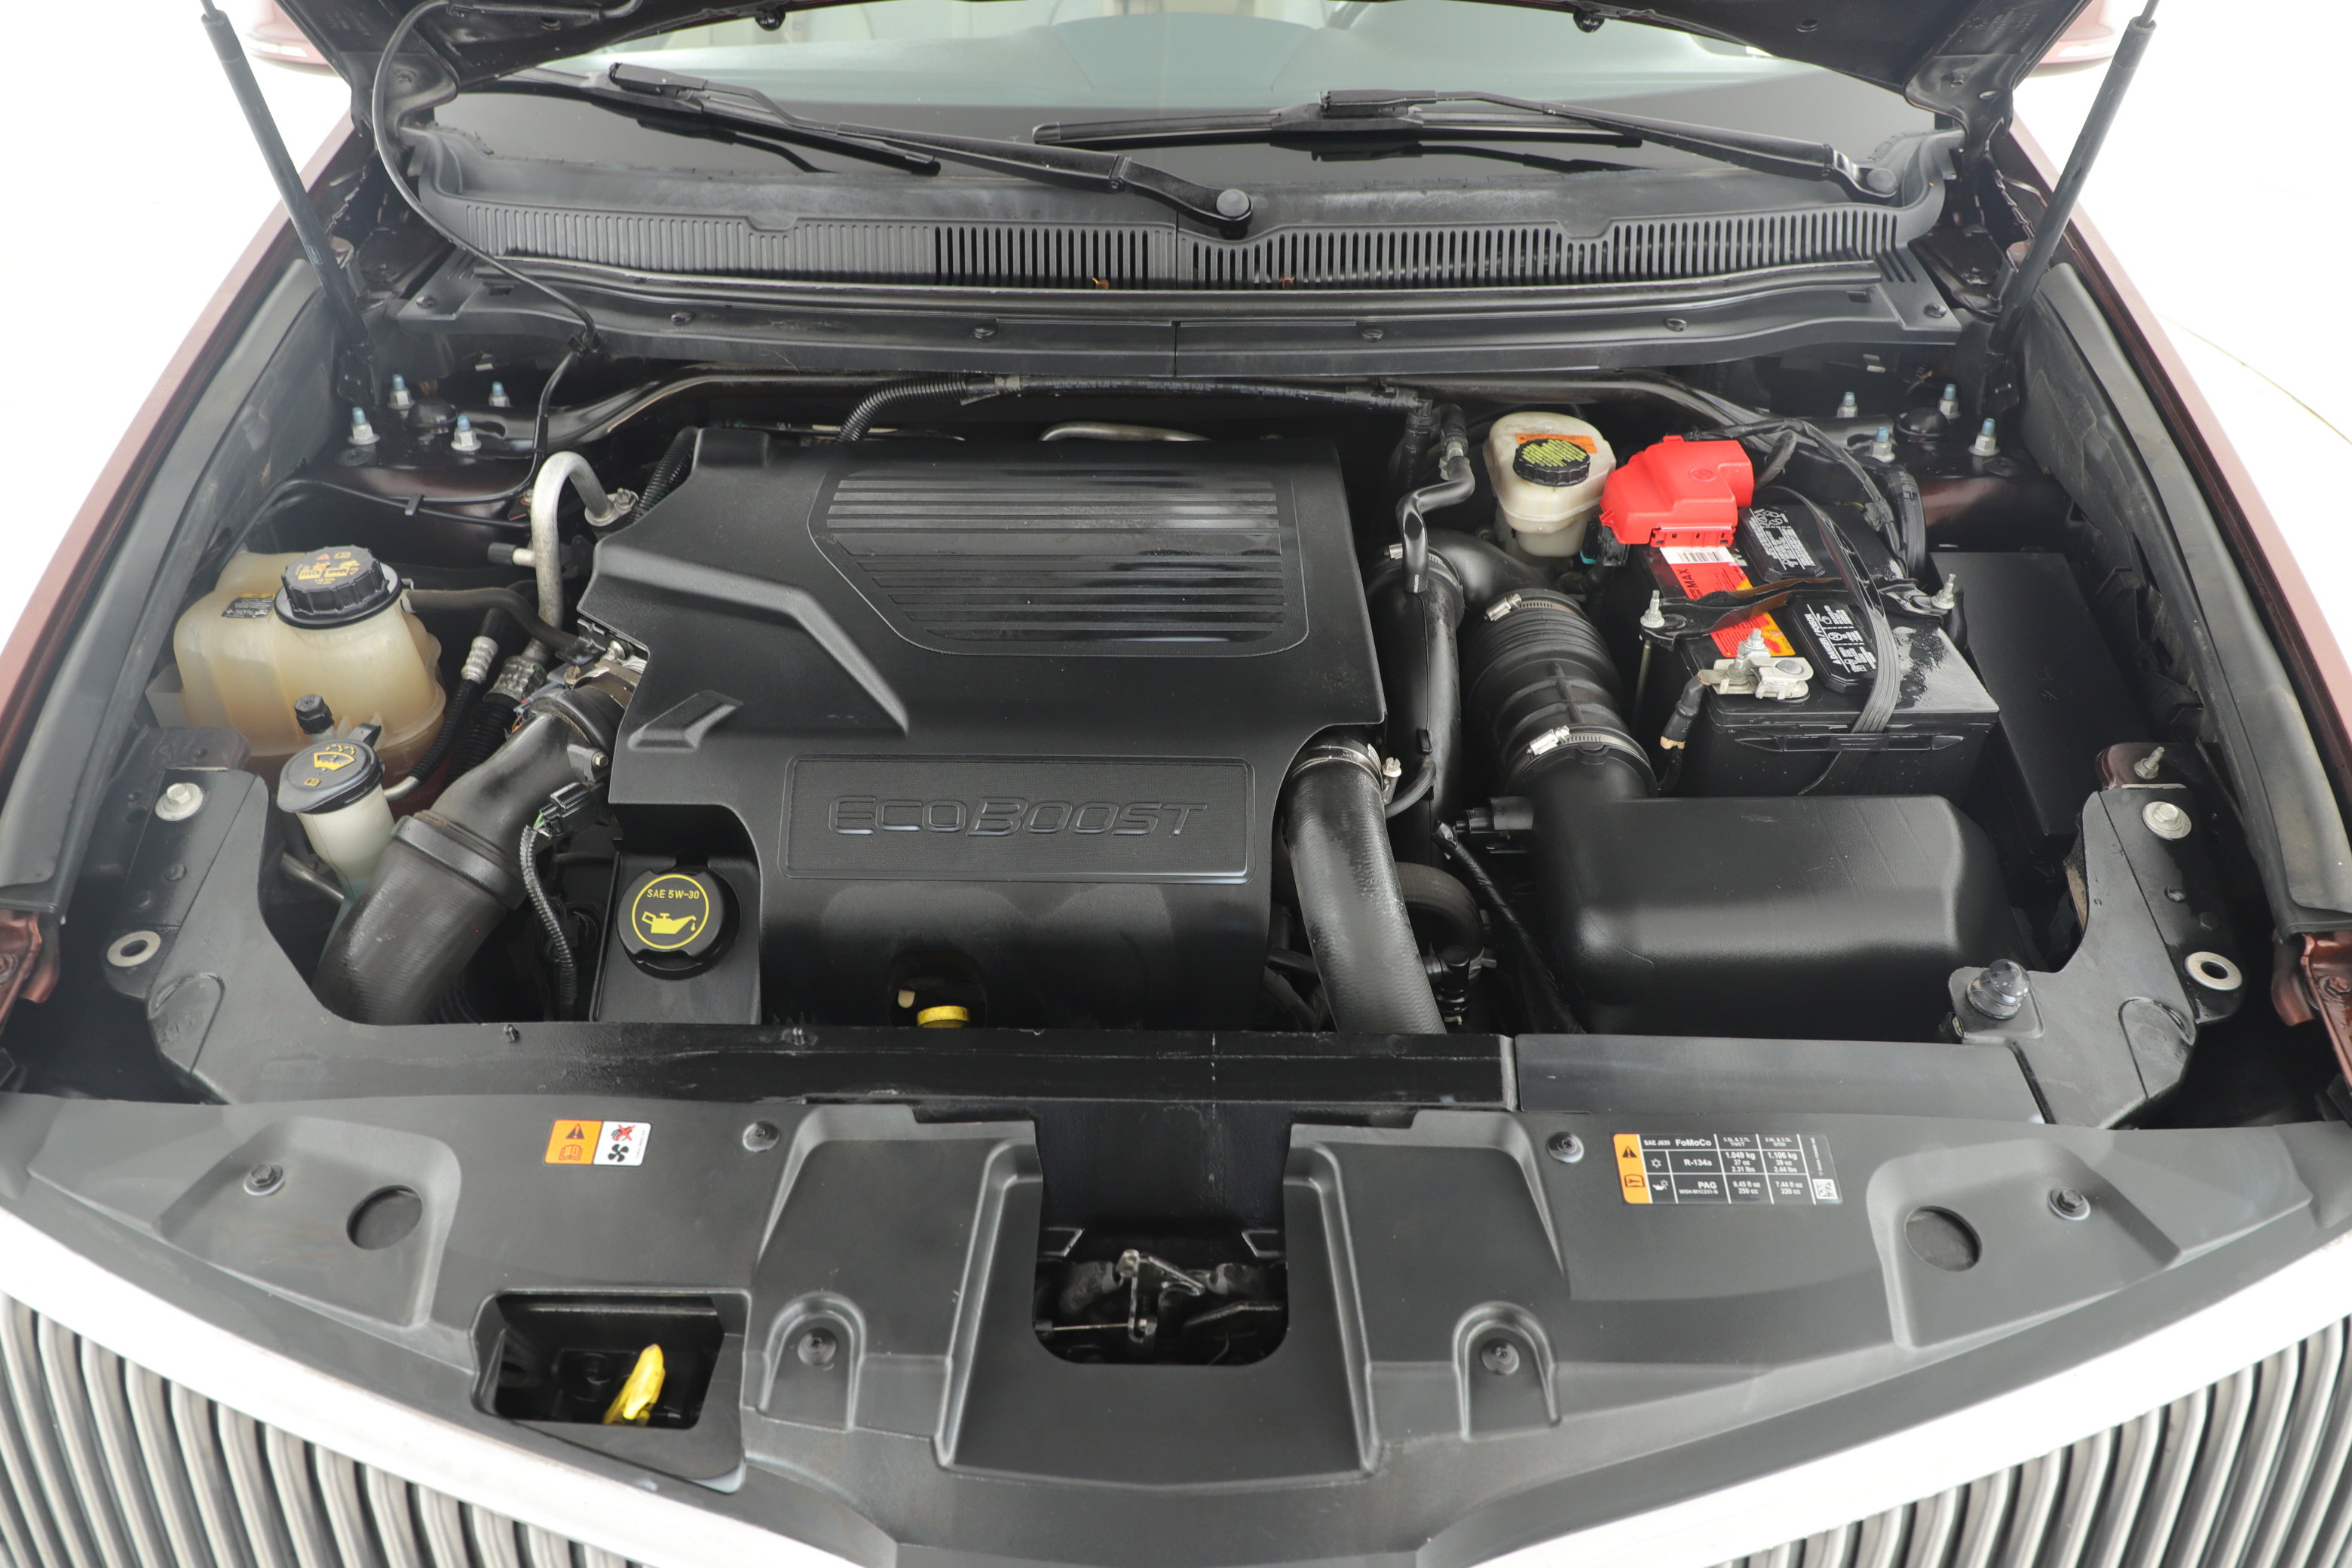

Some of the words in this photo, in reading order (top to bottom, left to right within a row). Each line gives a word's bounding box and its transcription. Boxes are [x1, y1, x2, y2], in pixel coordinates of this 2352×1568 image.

[1677, 568, 1698, 588] MAX
[1804, 614, 1823, 633] POISON
[1819, 637, 1839, 660] DANGER
[647, 889, 666, 899] SAE
[668, 890, 700, 899] 5W-30
[1674, 1138, 1712, 1147] FoMoCo
[1745, 1152, 1756, 1160] kg
[1787, 1152, 1798, 1160] kg
